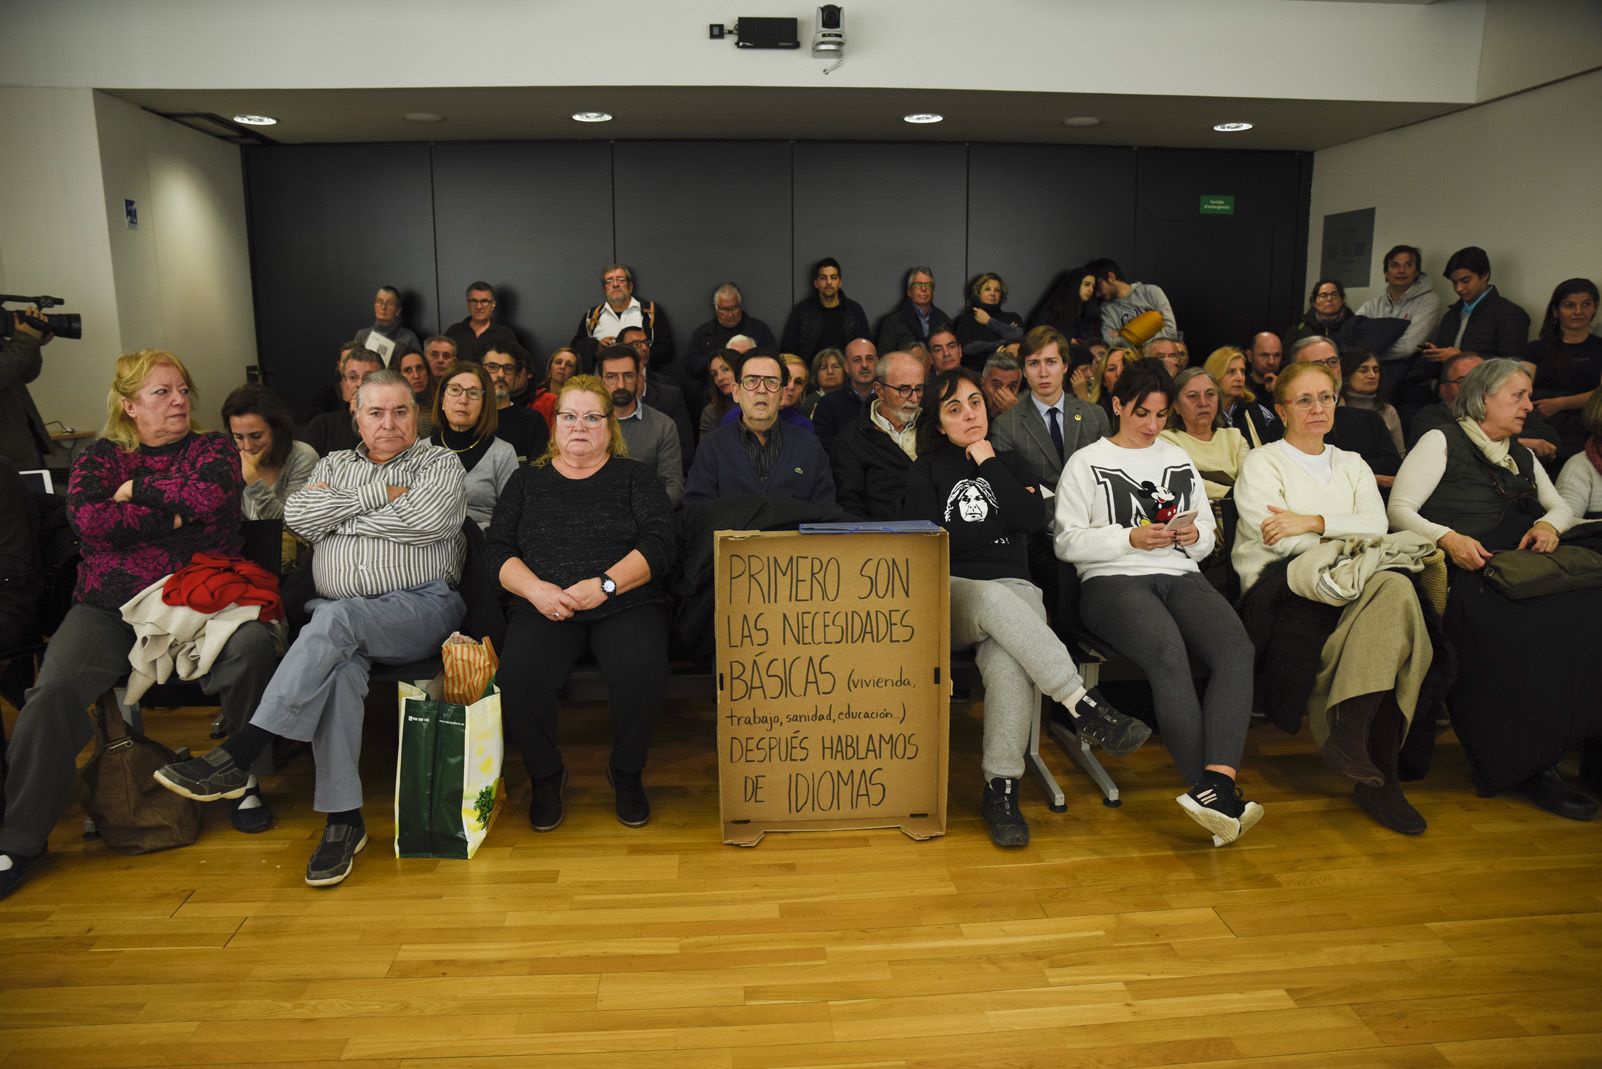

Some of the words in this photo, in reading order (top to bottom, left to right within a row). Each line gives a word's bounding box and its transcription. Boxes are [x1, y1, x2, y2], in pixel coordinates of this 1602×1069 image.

[729, 554, 840, 605] PRIMERO
[858, 557, 910, 599] SON
[727, 612, 769, 648] LAS
[782, 609, 915, 645] NECESIDADES
[729, 651, 836, 701] BÁSICAS
[847, 666, 917, 693] (vivienda,
[726, 708, 783, 732] trabajo,
[785, 704, 836, 723] sanidad,
[730, 730, 809, 763] DESPUÉS
[821, 733, 919, 760] HABLAMOS
[744, 774, 766, 803] DE
[788, 768, 886, 814] IDIOMAS
